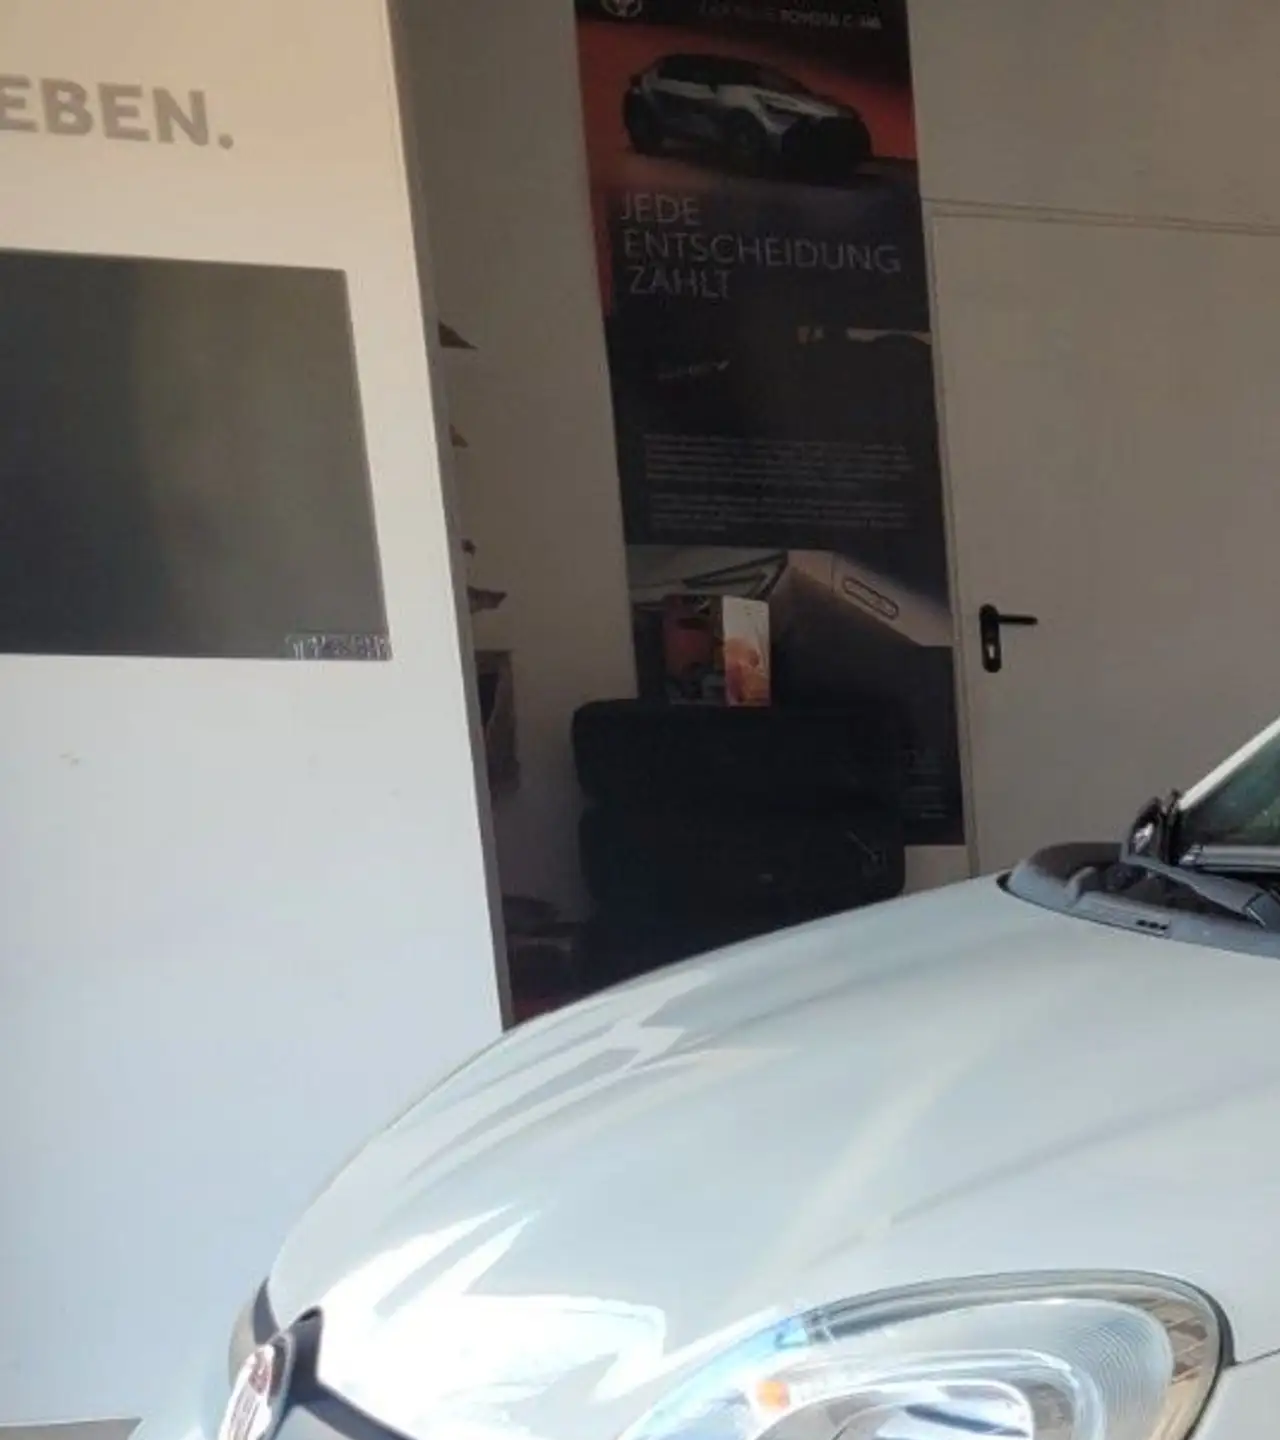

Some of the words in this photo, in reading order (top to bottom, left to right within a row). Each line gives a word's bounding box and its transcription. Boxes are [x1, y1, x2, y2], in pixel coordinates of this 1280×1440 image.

[0, 73, 235, 150] EBEN.
[620, 194, 702, 225] JEDE
[624, 229, 902, 273] ENTSCHEIDUNG
